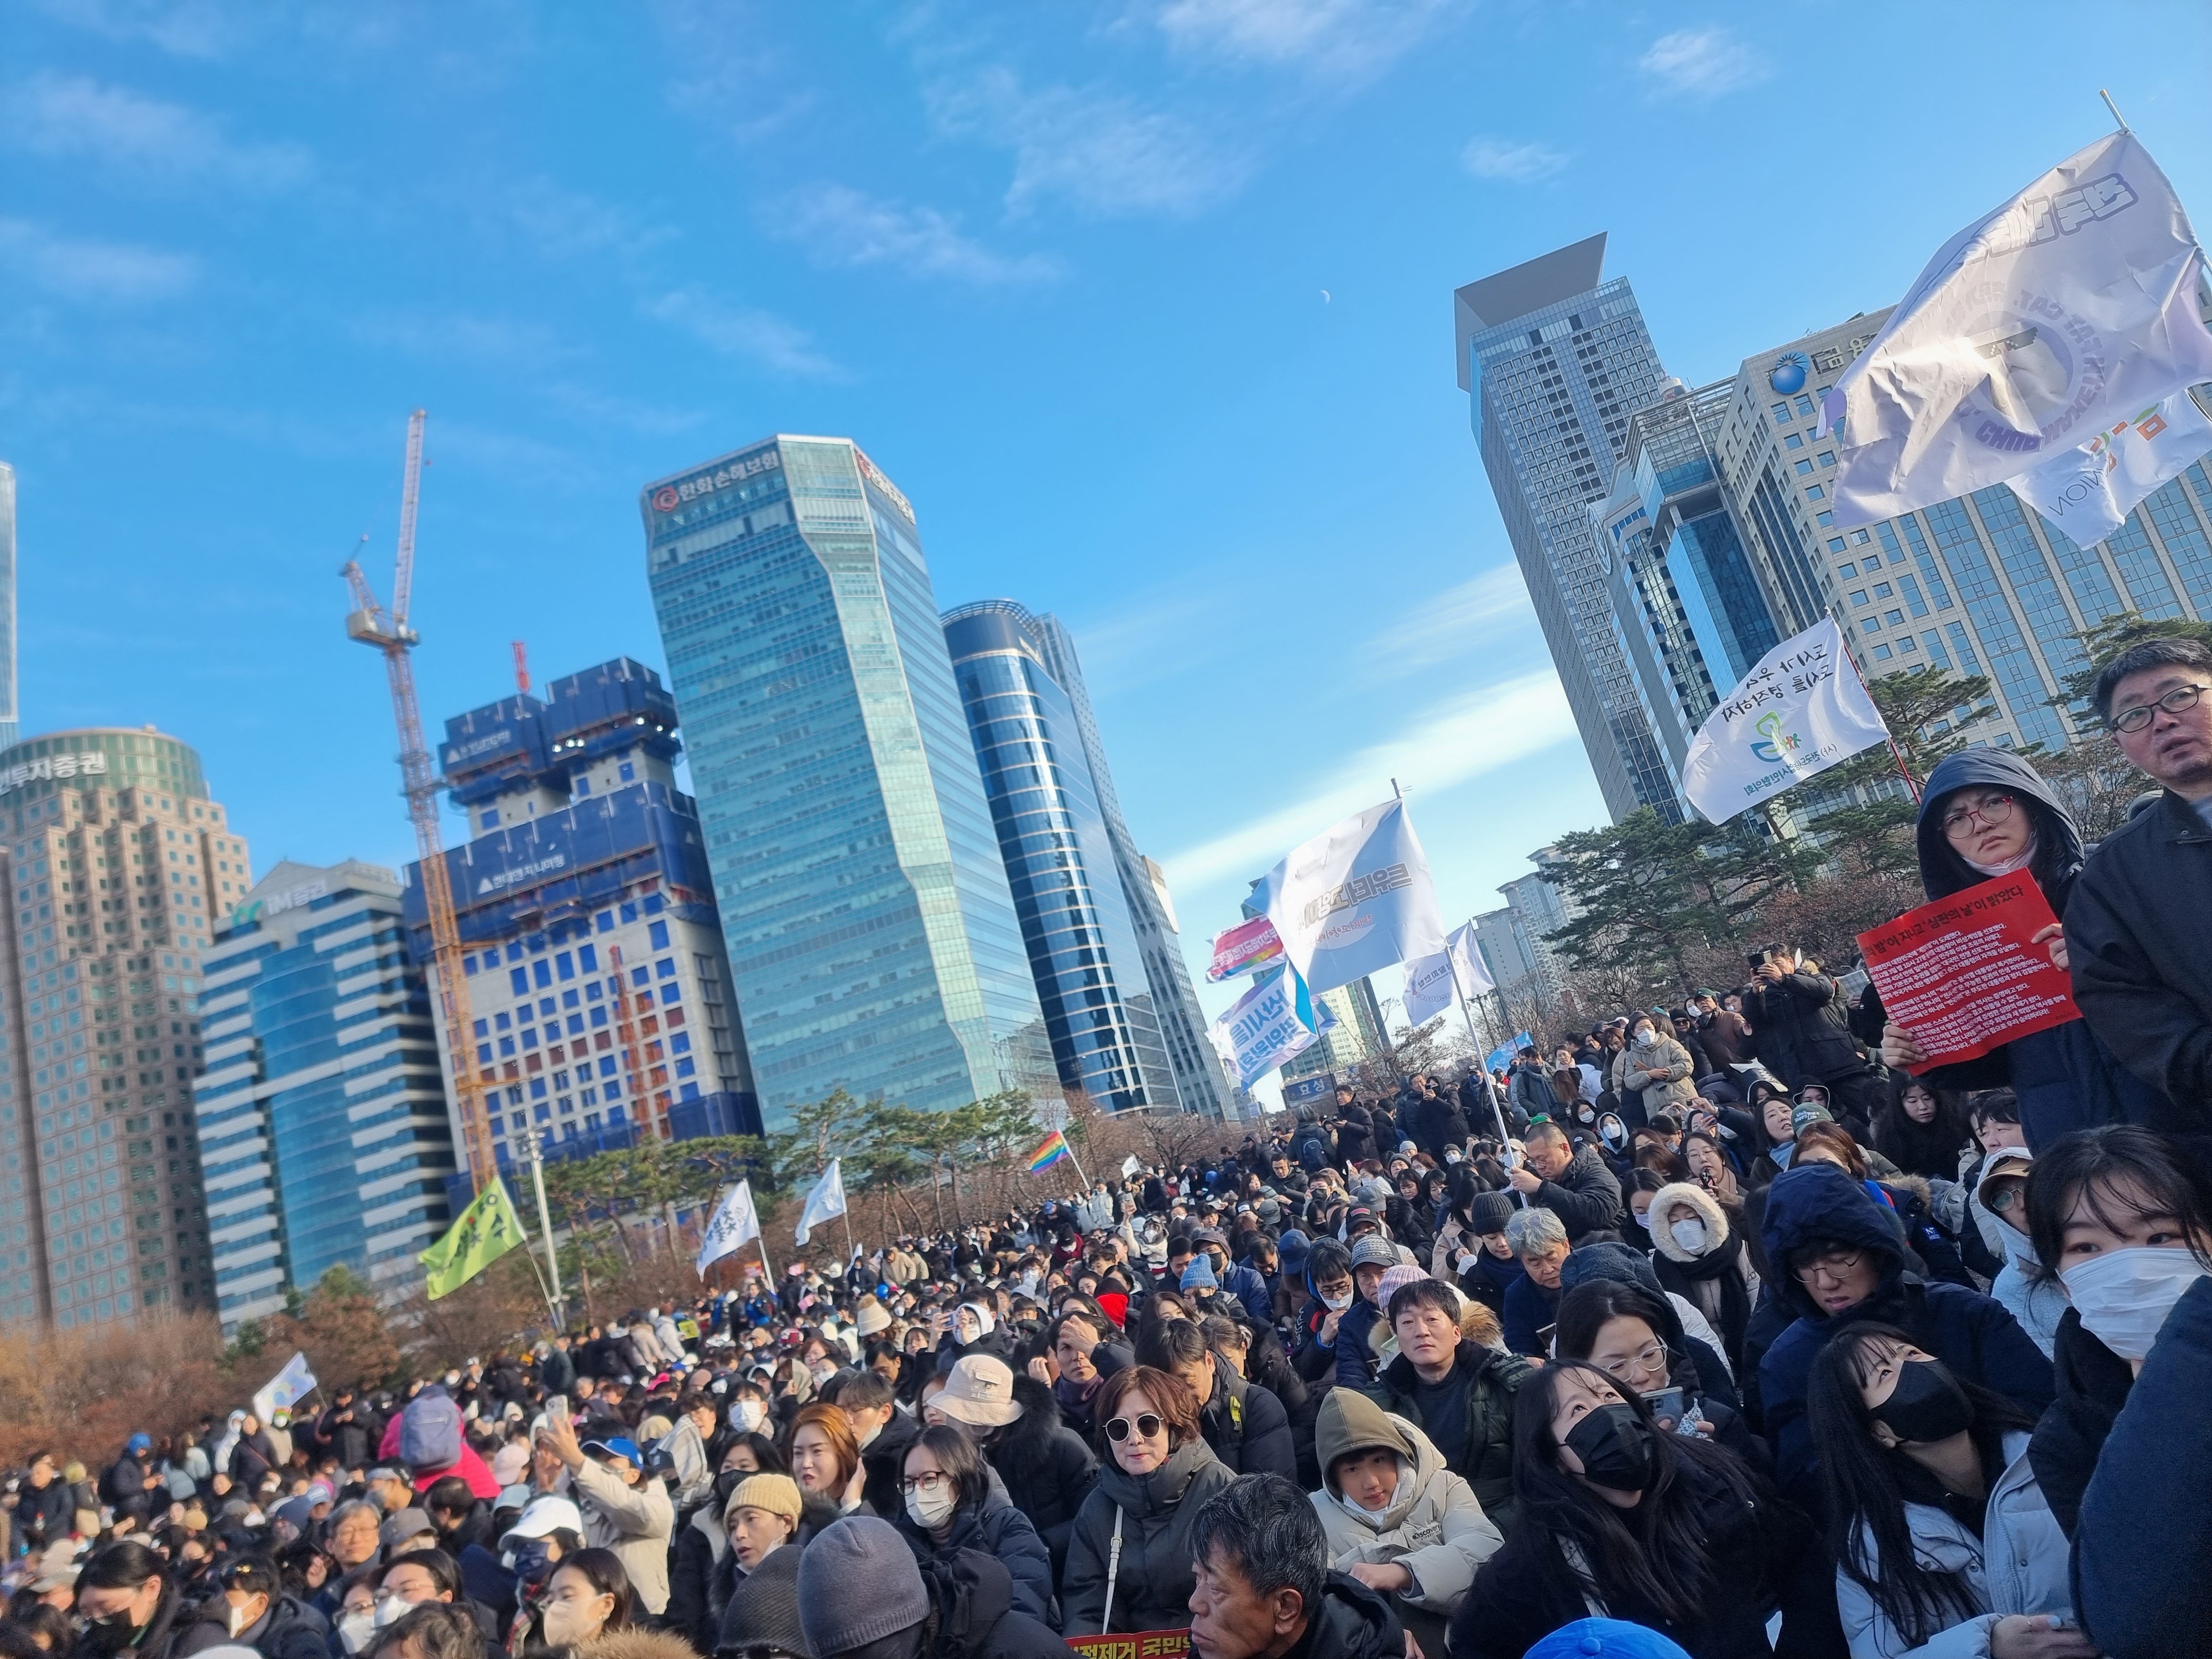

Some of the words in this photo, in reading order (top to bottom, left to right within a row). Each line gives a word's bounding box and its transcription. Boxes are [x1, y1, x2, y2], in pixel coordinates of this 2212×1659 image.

[678, 450, 780, 502] 한화손해보험
[1986, 884, 2025, 907] 밝았다
[1298, 1077, 1325, 1095] 효성
[1071, 1641, 1136, 1659] 적제거
[1142, 1636, 1191, 1656] 국민
